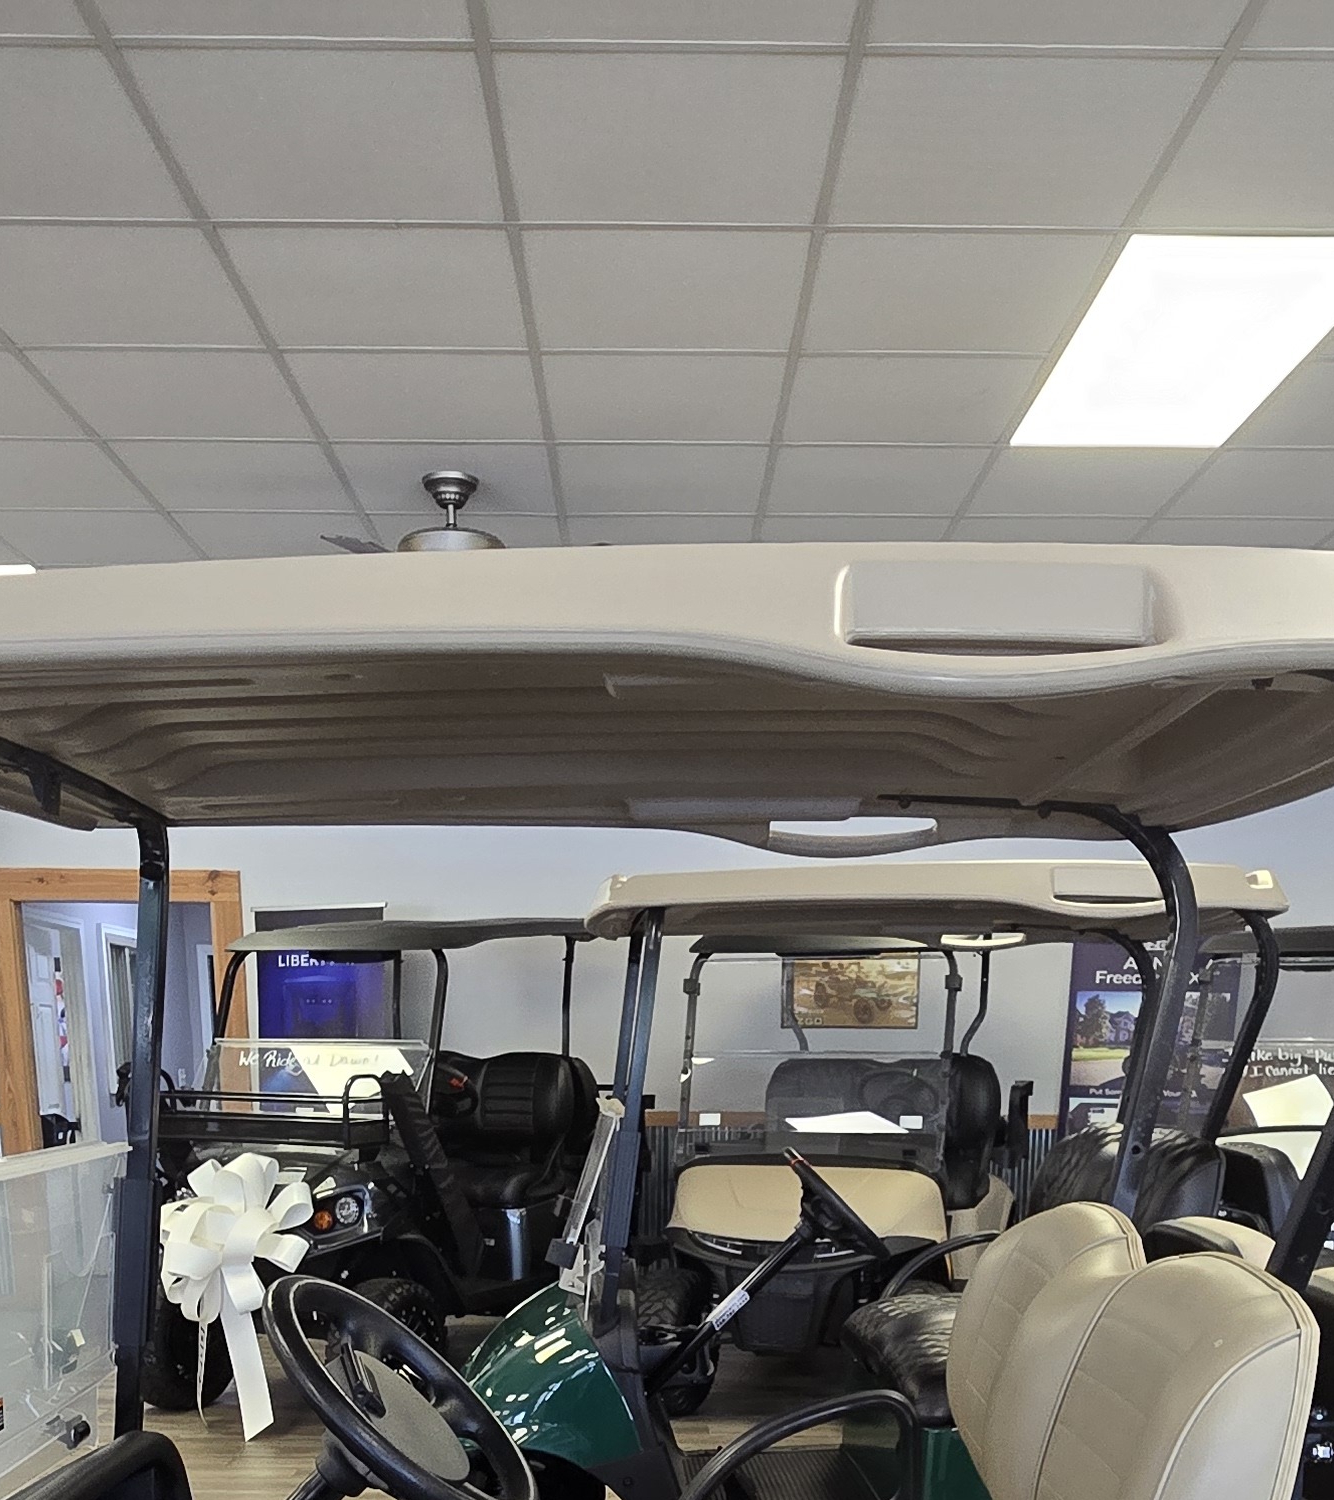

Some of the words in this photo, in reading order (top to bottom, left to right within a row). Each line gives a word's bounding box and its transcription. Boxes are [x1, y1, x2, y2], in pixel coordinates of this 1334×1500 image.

[238, 1050, 260, 1067] We
[263, 1049, 298, 1068] Ride
[1247, 1049, 1274, 1063] ike
[1278, 1047, 1302, 1067] big
